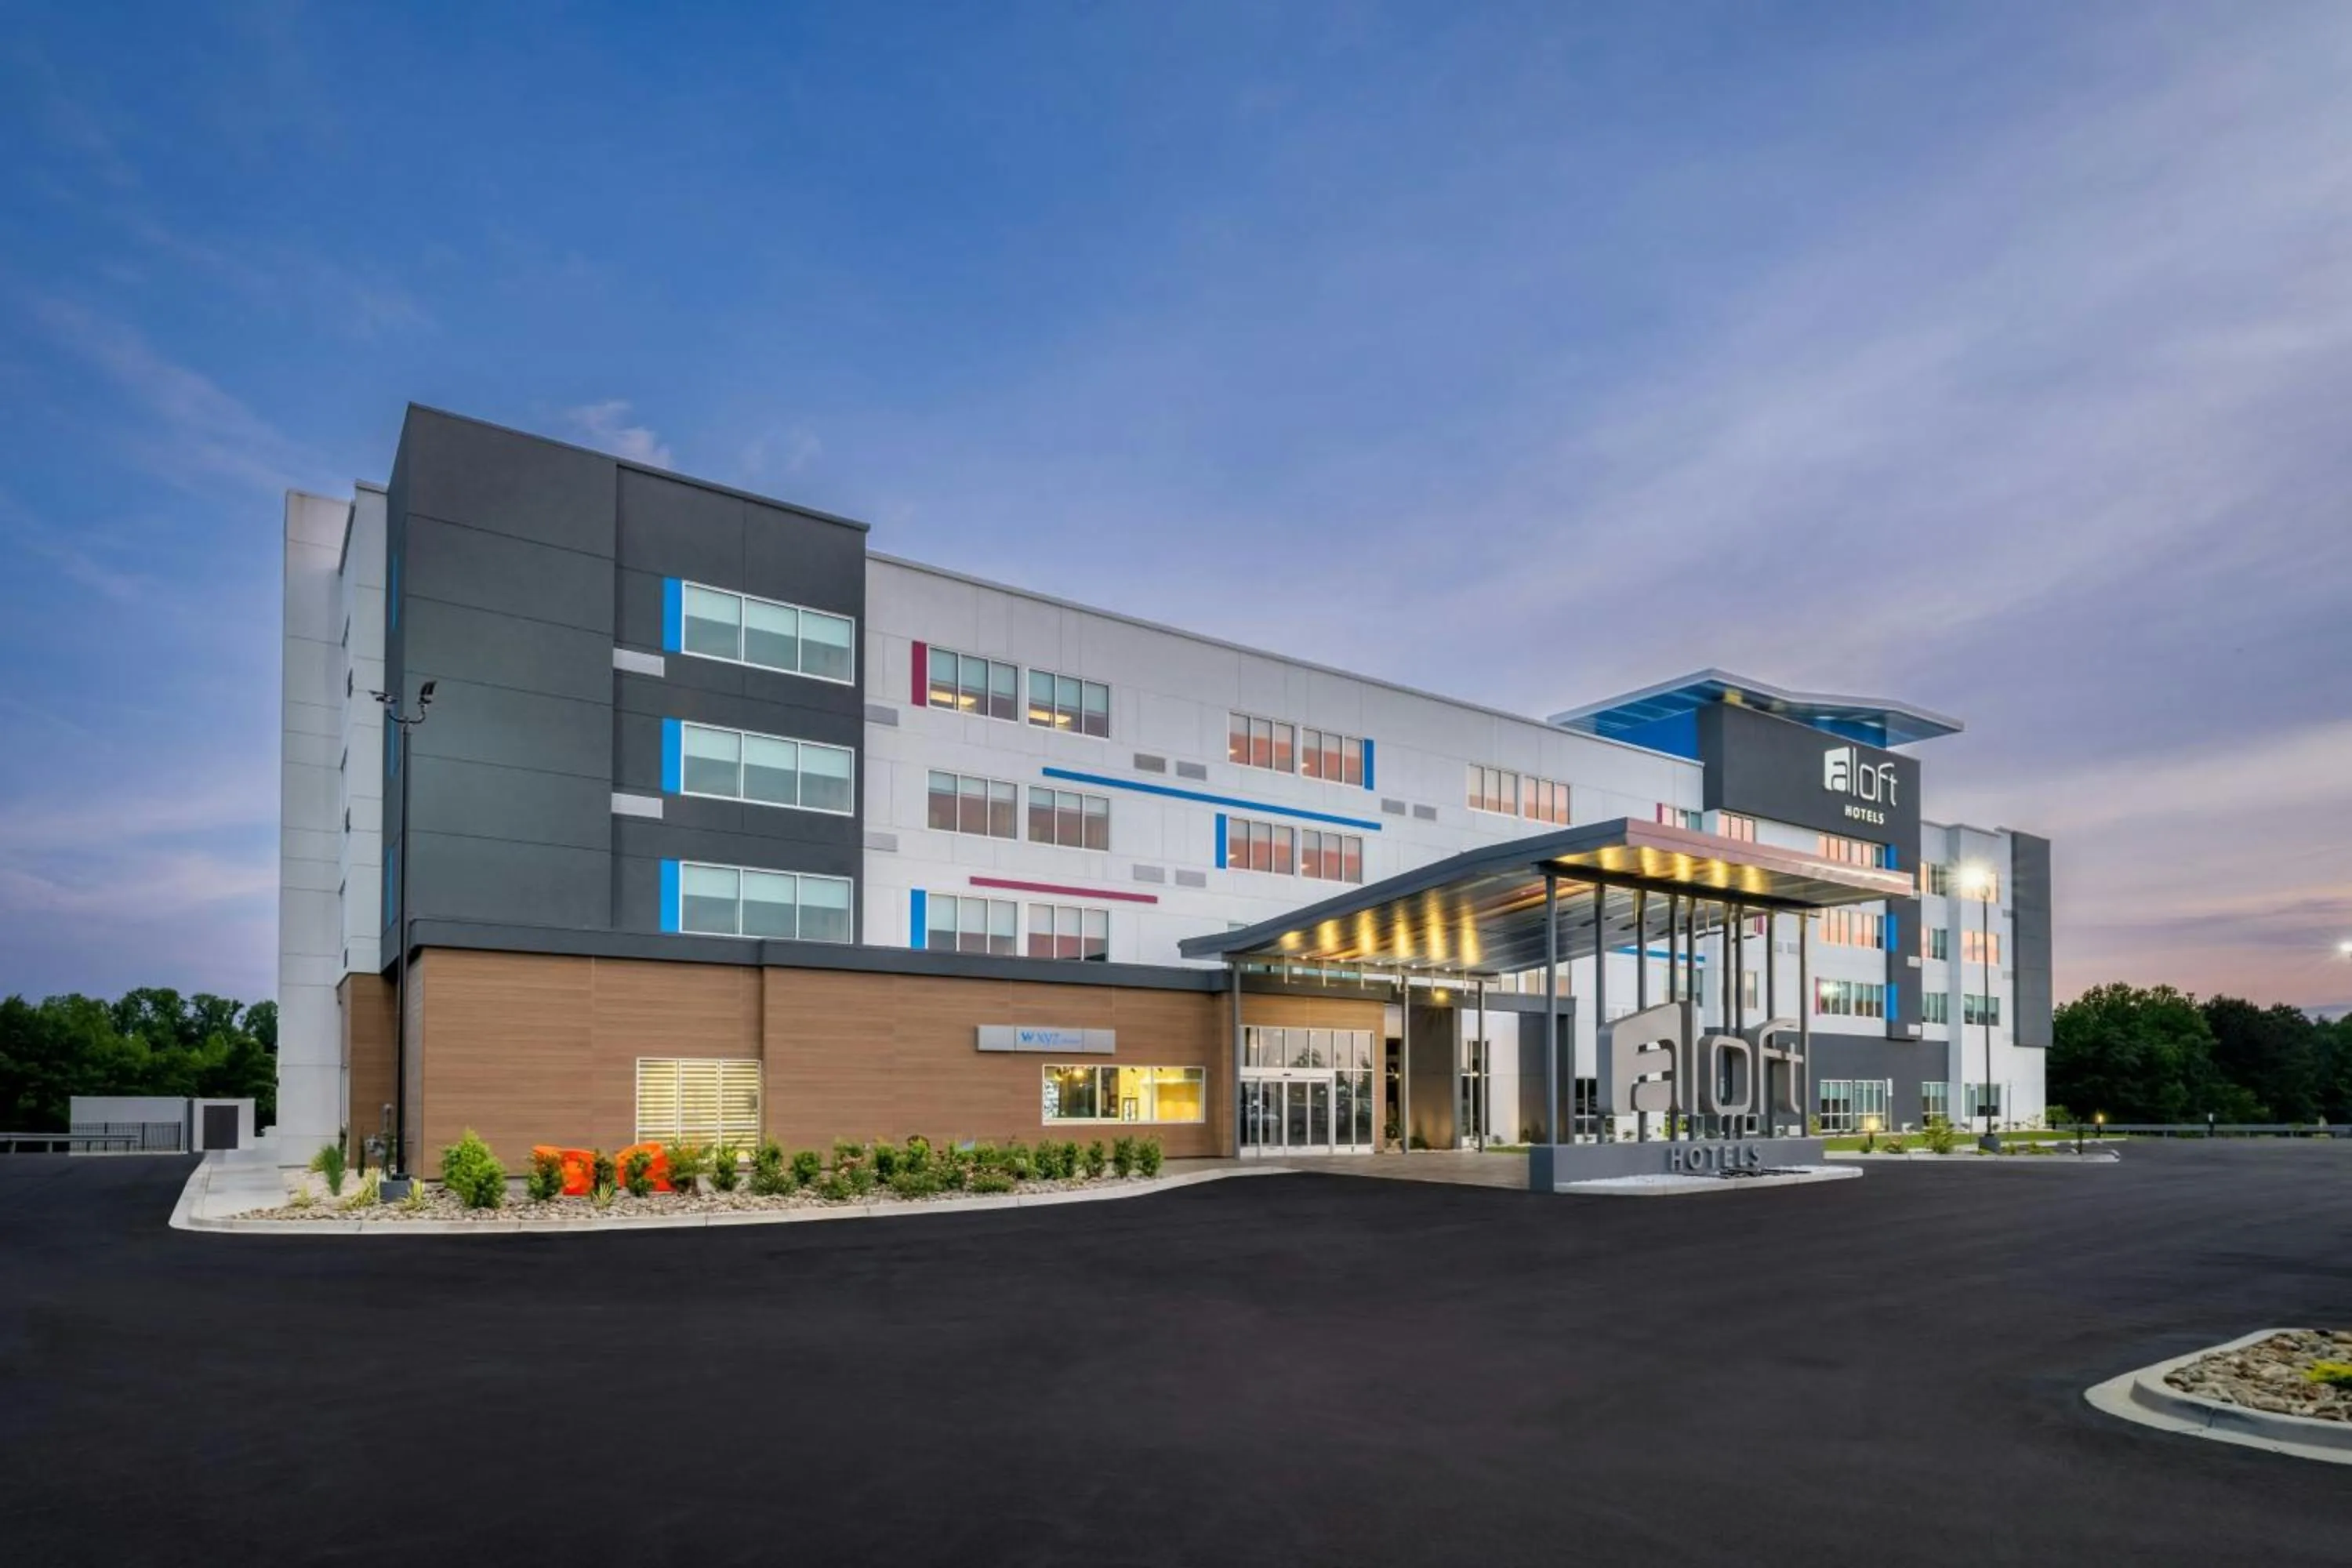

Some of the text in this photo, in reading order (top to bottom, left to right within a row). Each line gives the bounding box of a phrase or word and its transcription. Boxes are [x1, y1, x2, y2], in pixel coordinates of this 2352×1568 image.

[1824, 746, 1897, 807] aloft
[1845, 804, 1885, 825] HOTELS
[1611, 1001, 1805, 1116] aloft
[1671, 1145, 1761, 1172] HOTELS
